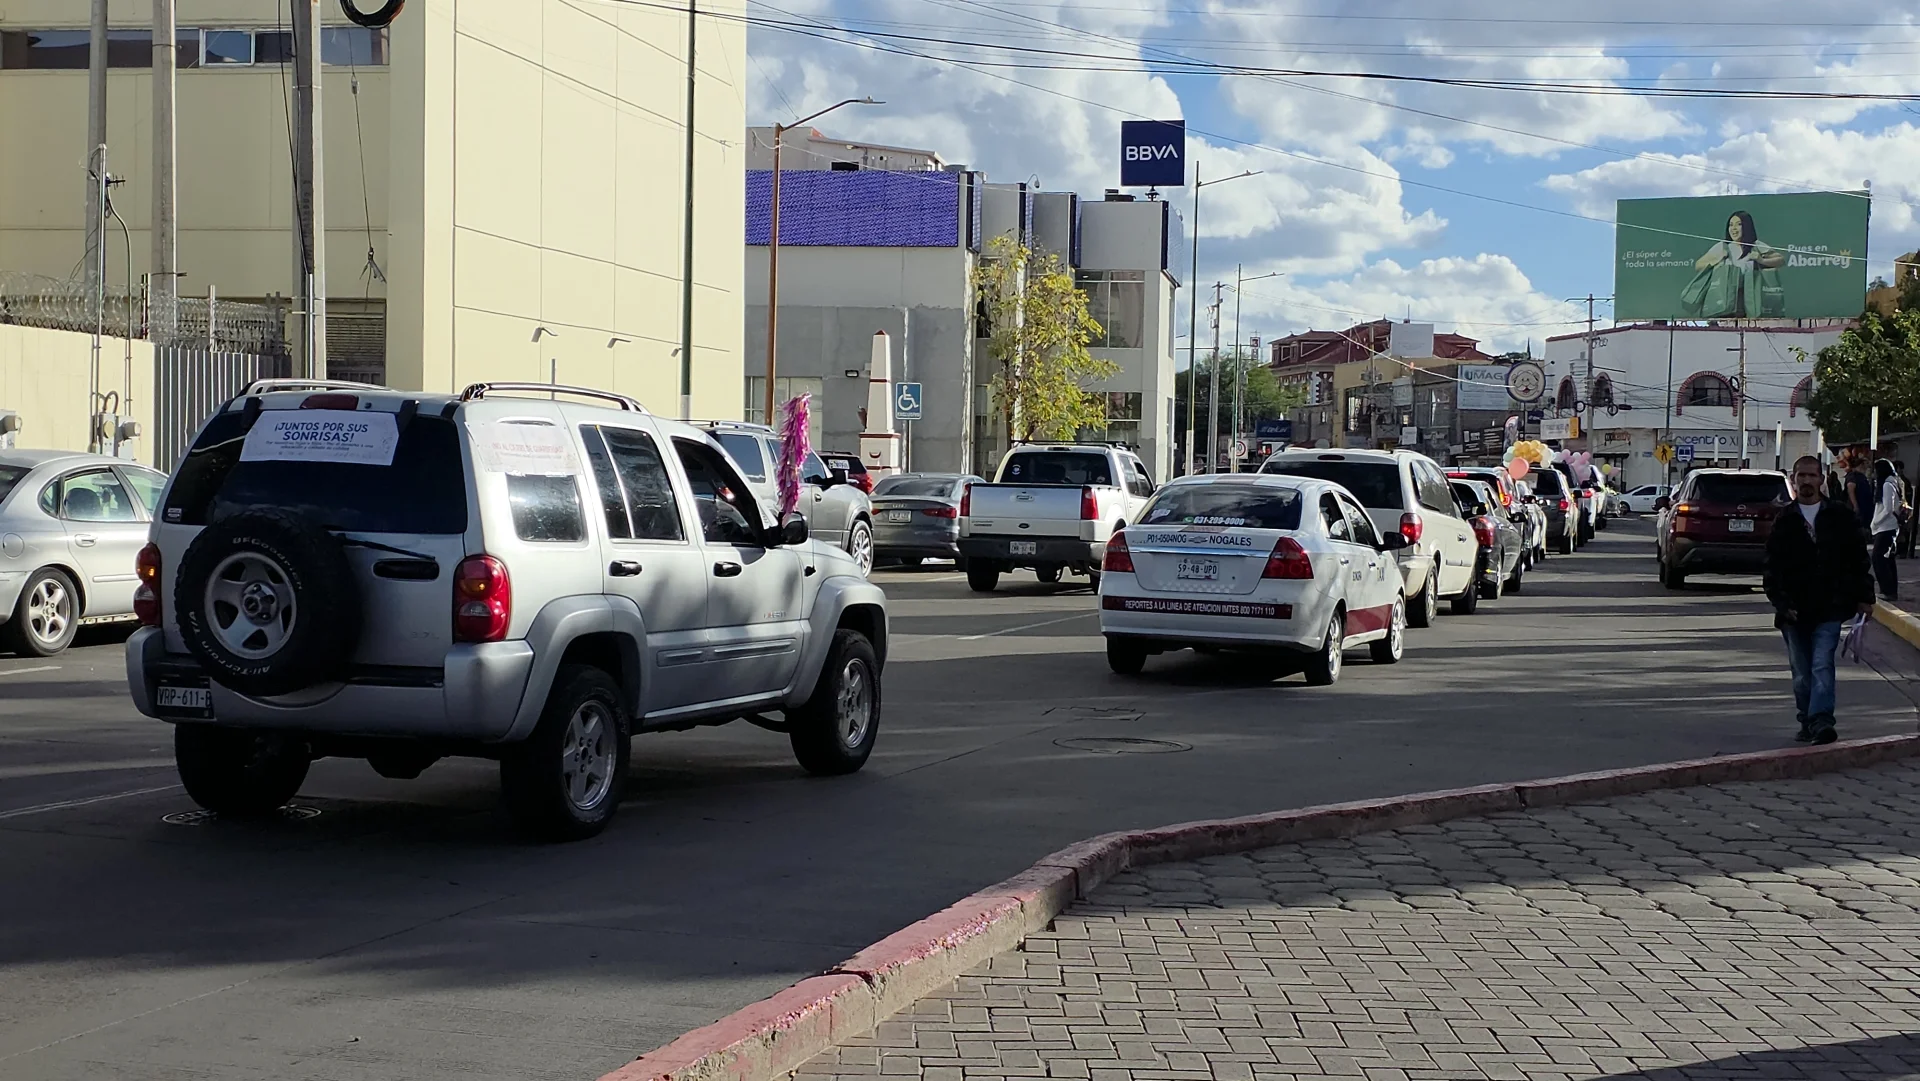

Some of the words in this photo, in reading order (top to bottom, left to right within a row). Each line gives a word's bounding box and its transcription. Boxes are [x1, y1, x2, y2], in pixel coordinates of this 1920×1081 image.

[1126, 143, 1179, 161] BBVA
[1788, 244, 1812, 252] Pues
[1636, 250, 1658, 259] súper
[1661, 250, 1672, 258] de
[1647, 260, 1655, 268] la
[1656, 259, 1694, 267] semana?
[1788, 254, 1851, 269] Abarrey
[274, 422, 320, 432] ¡JUNTOS
[322, 422, 343, 432] POR
[348, 423, 368, 433] SUS
[283, 431, 354, 442] SONRISAS!
[1209, 535, 1252, 547] NOGALES
[1125, 600, 1152, 610] REPORTES
[1159, 602, 1166, 610] LA
[1167, 603, 1182, 611] LINEA
[1184, 604, 1192, 612] DE
[1193, 604, 1221, 613] ATENCION
[1240, 607, 1250, 615] 800
[1251, 607, 1264, 615] 7171
[1265, 608, 1275, 616] 110
